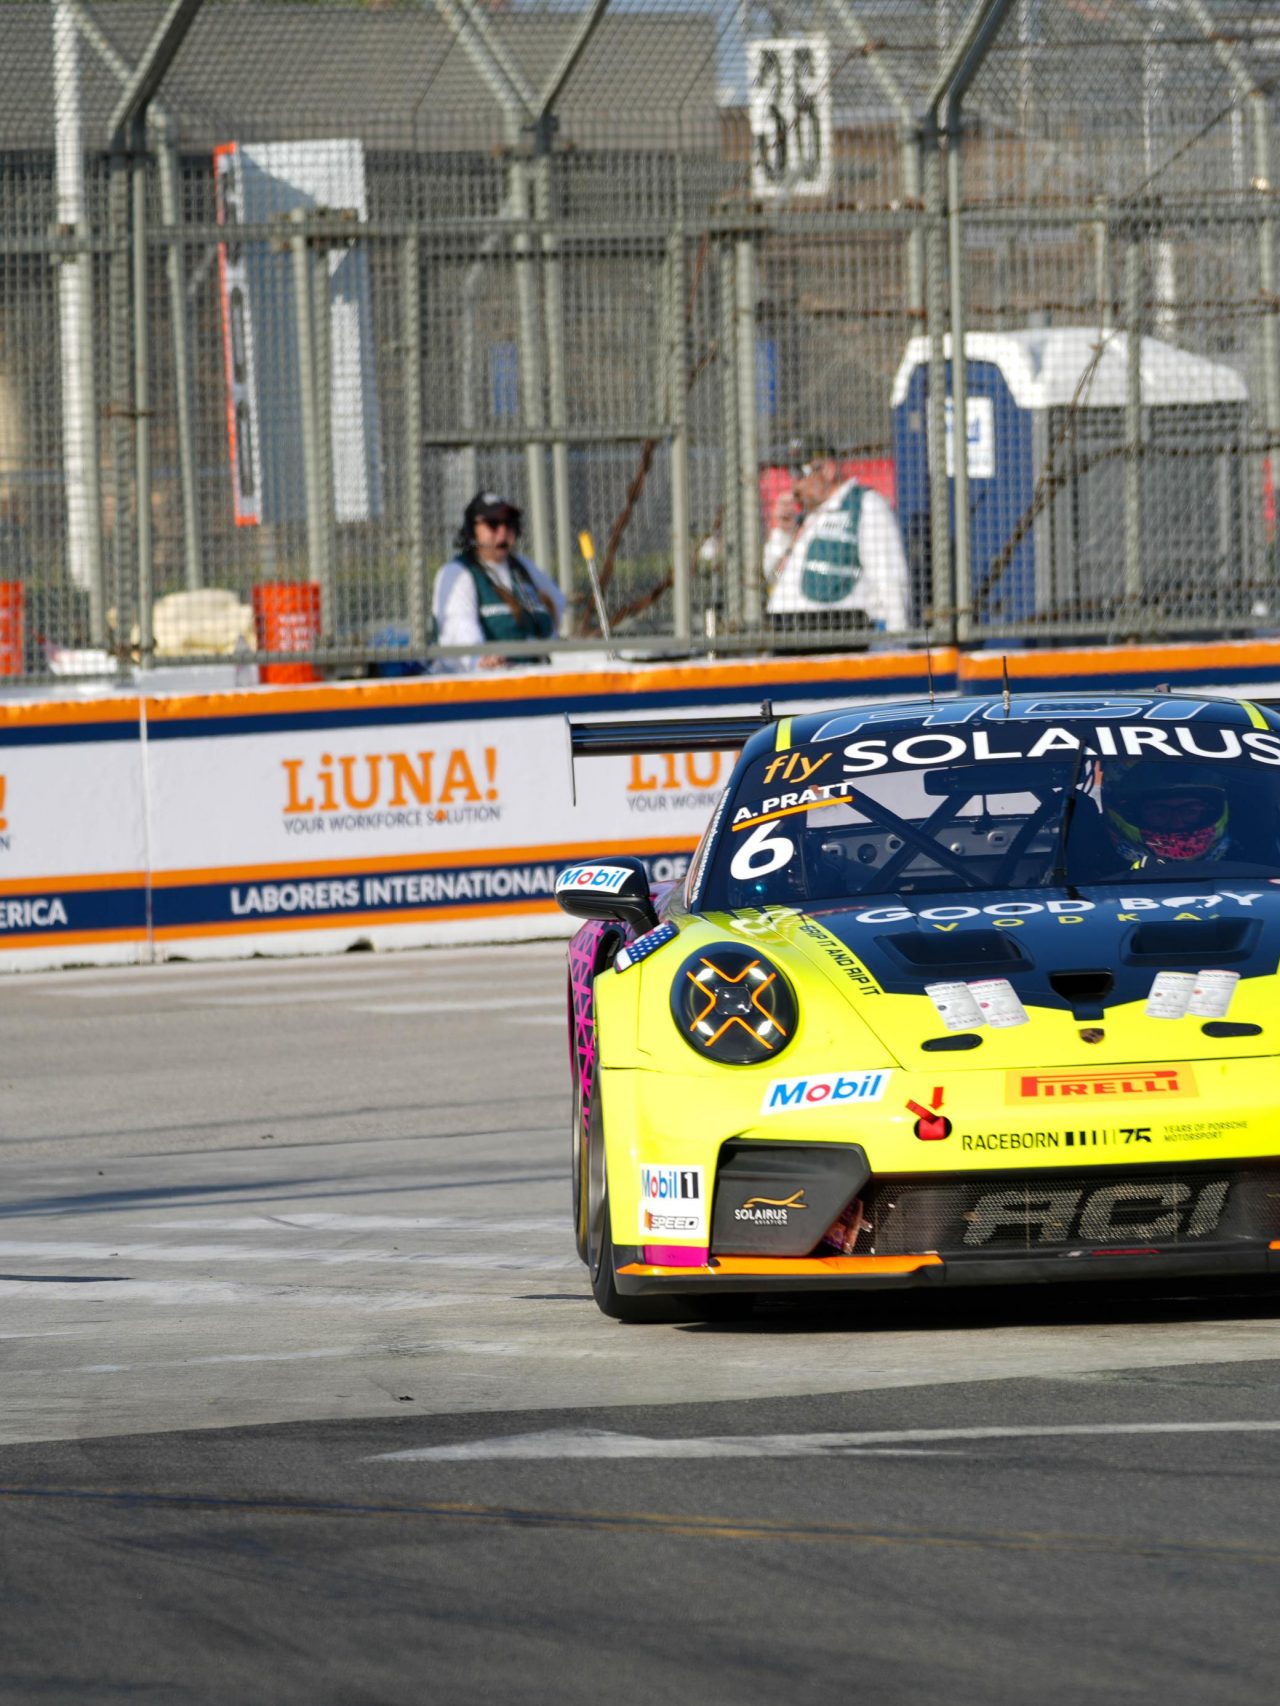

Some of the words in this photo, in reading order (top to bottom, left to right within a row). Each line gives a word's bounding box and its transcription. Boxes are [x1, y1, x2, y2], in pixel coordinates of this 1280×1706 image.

[281, 746, 498, 814] LiUNA!
[764, 753, 832, 783] fly
[627, 793, 667, 813] YOUR
[733, 805, 758, 823] A.
[762, 782, 853, 814] PRATT
[283, 817, 325, 835] YOUR
[329, 811, 423, 832] WORKFORCE
[426, 805, 501, 826] SOLUTION
[730, 819, 795, 880] 6
[558, 869, 627, 888] Mobil
[230, 879, 360, 914] LABORERS
[856, 900, 1096, 923] GOOD
[933, 910, 1211, 932] VODKA
[825, 949, 855, 967] AND
[843, 967, 871, 984] RIP
[859, 985, 881, 996] IT
[770, 1074, 882, 1107] Mobil
[1021, 1070, 1179, 1097] PIRELLI
[962, 1131, 1058, 1151] RACEBORN
[1119, 1127, 1151, 1144] 75
[641, 1170, 677, 1199] Mobil
[682, 1172, 698, 1199] 1
[734, 1208, 788, 1221] SOLAIRUS
